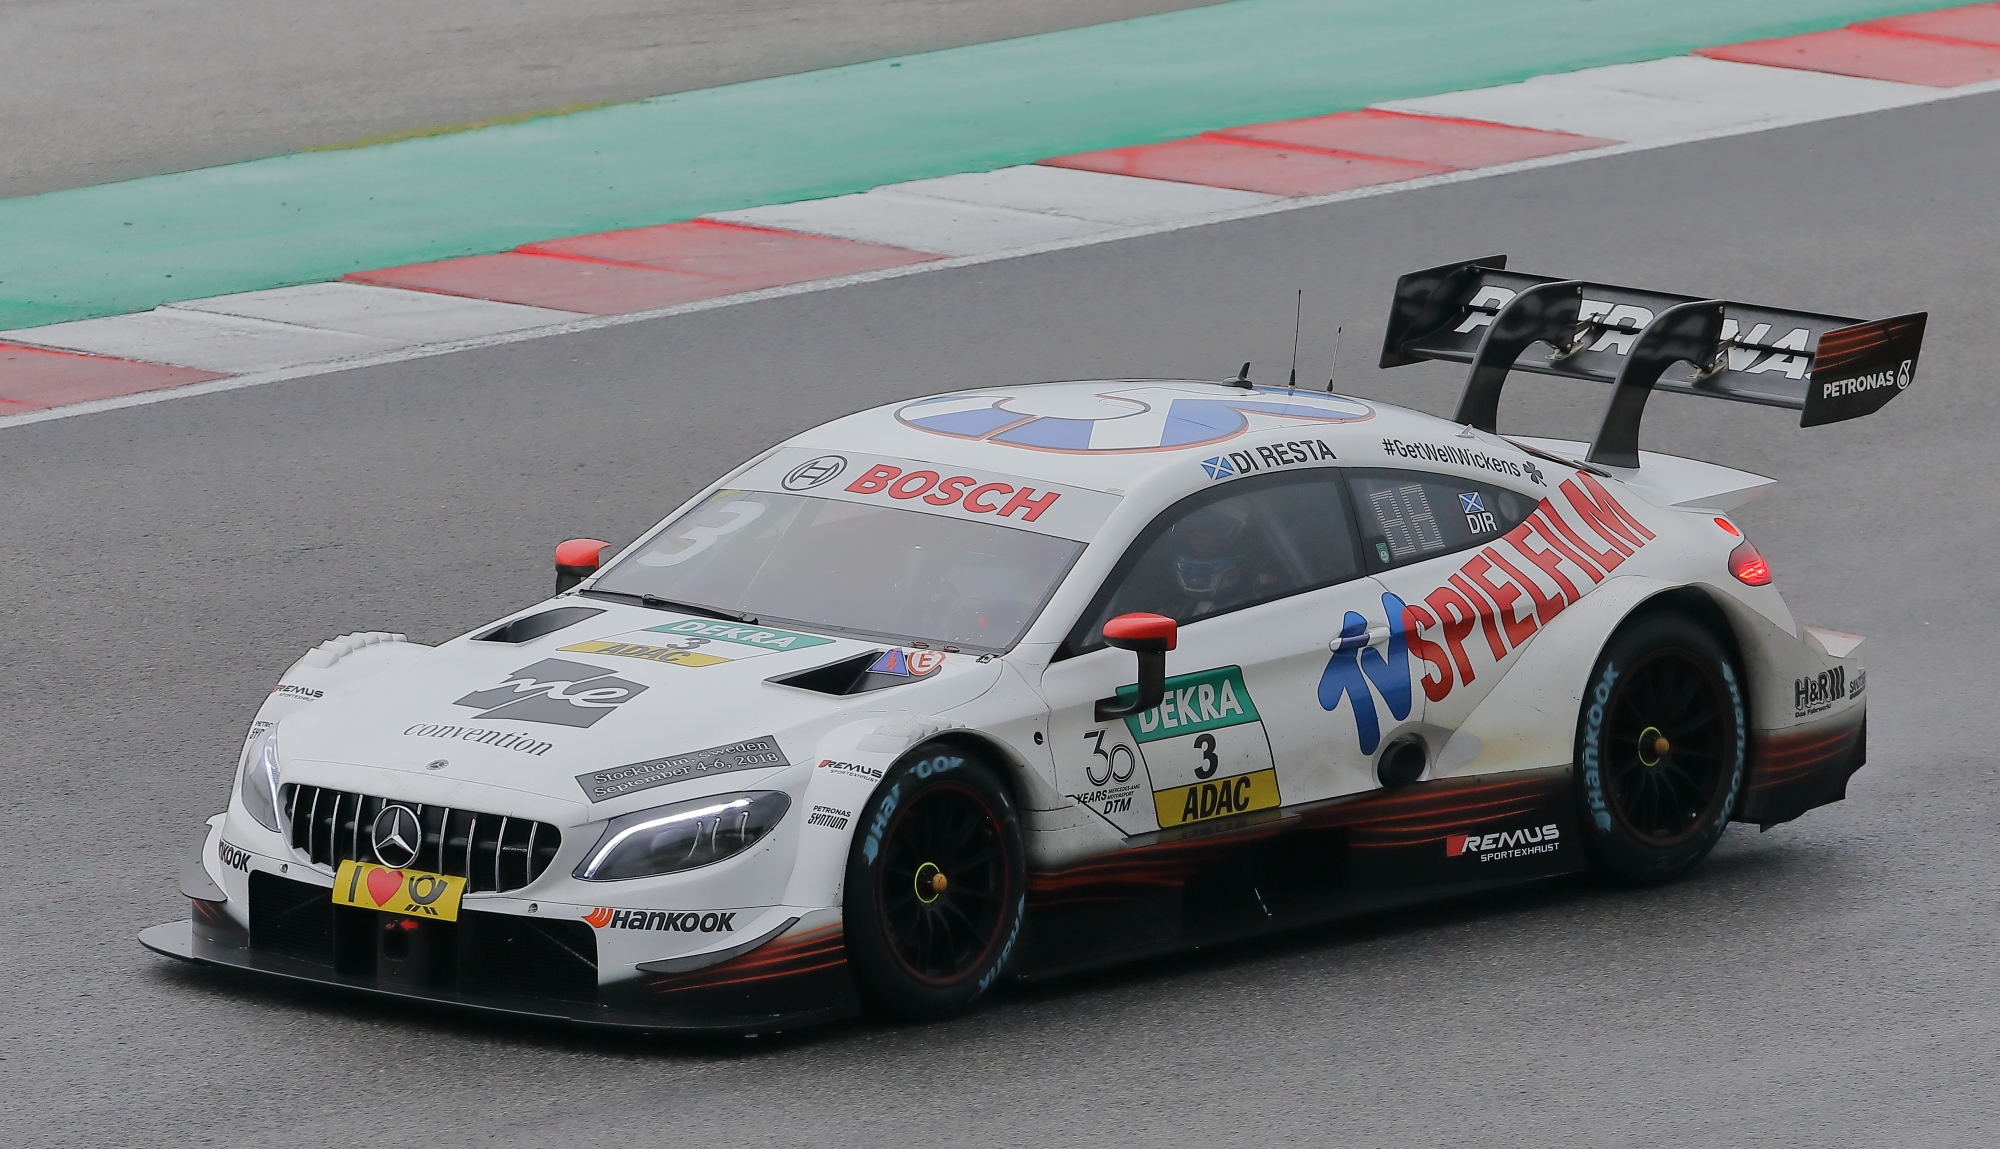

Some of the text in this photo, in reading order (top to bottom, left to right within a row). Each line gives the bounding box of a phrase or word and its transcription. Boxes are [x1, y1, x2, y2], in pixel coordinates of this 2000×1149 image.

[1453, 286, 1812, 380] PTRNA
[1823, 370, 1894, 399] PETRONAS
[1228, 439, 1337, 475] DI RESTA
[1381, 437, 1521, 478] #GetWellWickens
[844, 463, 1061, 523] BOSCH
[636, 500, 766, 567] 3
[1466, 511, 1498, 535] DIR
[1402, 470, 1657, 703] SPIELFILM
[665, 637, 712, 650] 3
[671, 620, 798, 648] DEKRA
[597, 642, 692, 663] ADAC
[278, 684, 324, 699] REMUS
[1795, 671, 1830, 711] H&R
[1138, 678, 1244, 734] DEKRA
[403, 721, 554, 758] convention
[593, 756, 696, 785] Stockholm,
[825, 760, 883, 779] REMUS
[1083, 728, 1136, 787] 30
[1193, 733, 1219, 780] 3
[593, 765, 691, 797] September
[734, 752, 779, 767] 2018
[829, 769, 879, 784] SPORTEXHAUST
[812, 805, 852, 818] PETRONAS
[1077, 789, 1108, 805] YEARS
[1103, 796, 1132, 815] DTM
[1181, 776, 1251, 823] ADAC
[807, 812, 849, 831] SYNTIUM
[1461, 823, 1560, 853] REMUS
[1480, 842, 1560, 863] SPORTEXHAUST
